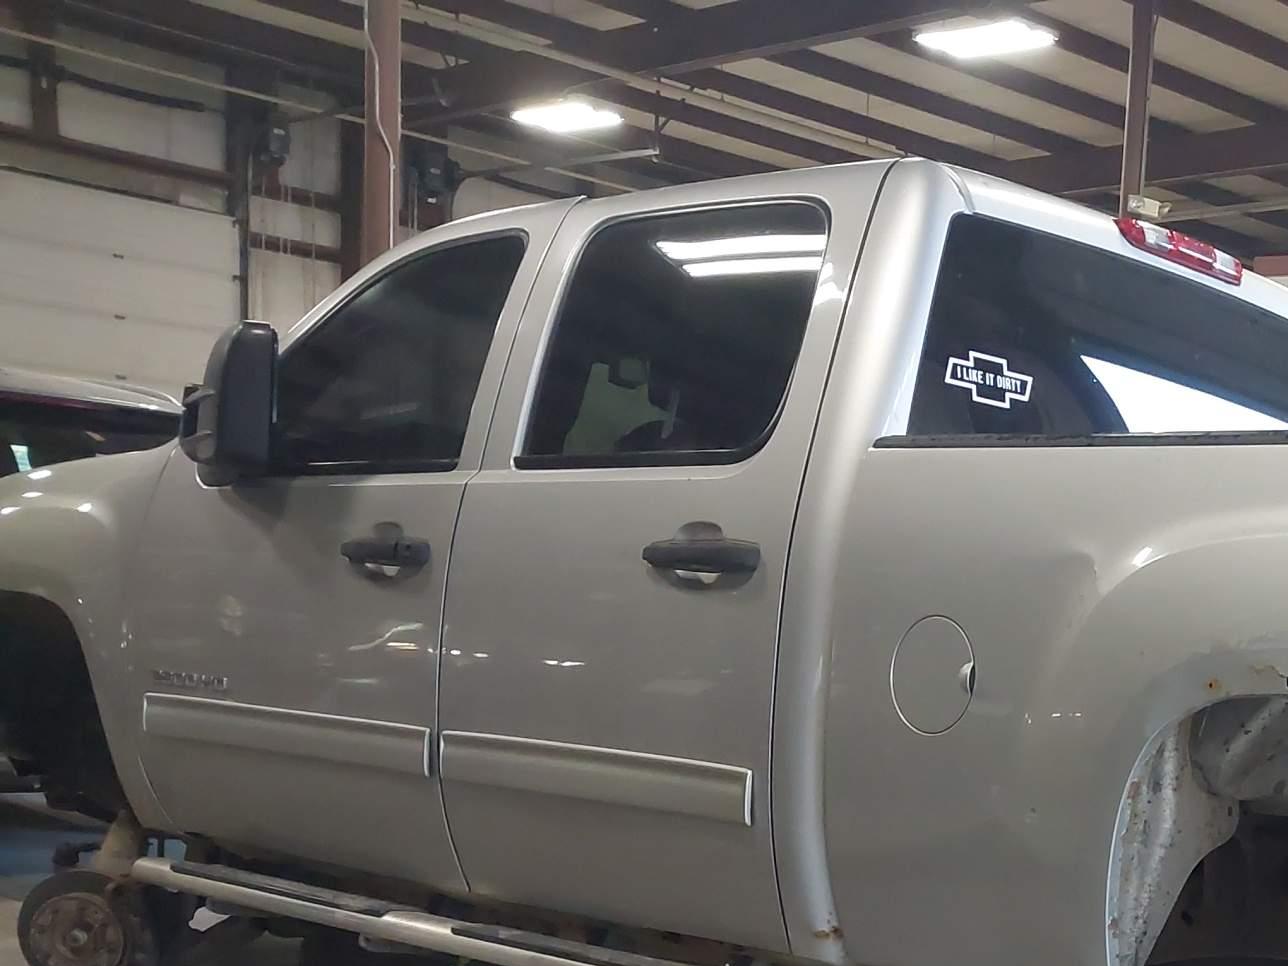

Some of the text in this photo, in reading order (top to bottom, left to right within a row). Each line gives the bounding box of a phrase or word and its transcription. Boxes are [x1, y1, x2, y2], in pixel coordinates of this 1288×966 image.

[956, 365, 1021, 392] I LIKE IT DIRTY
